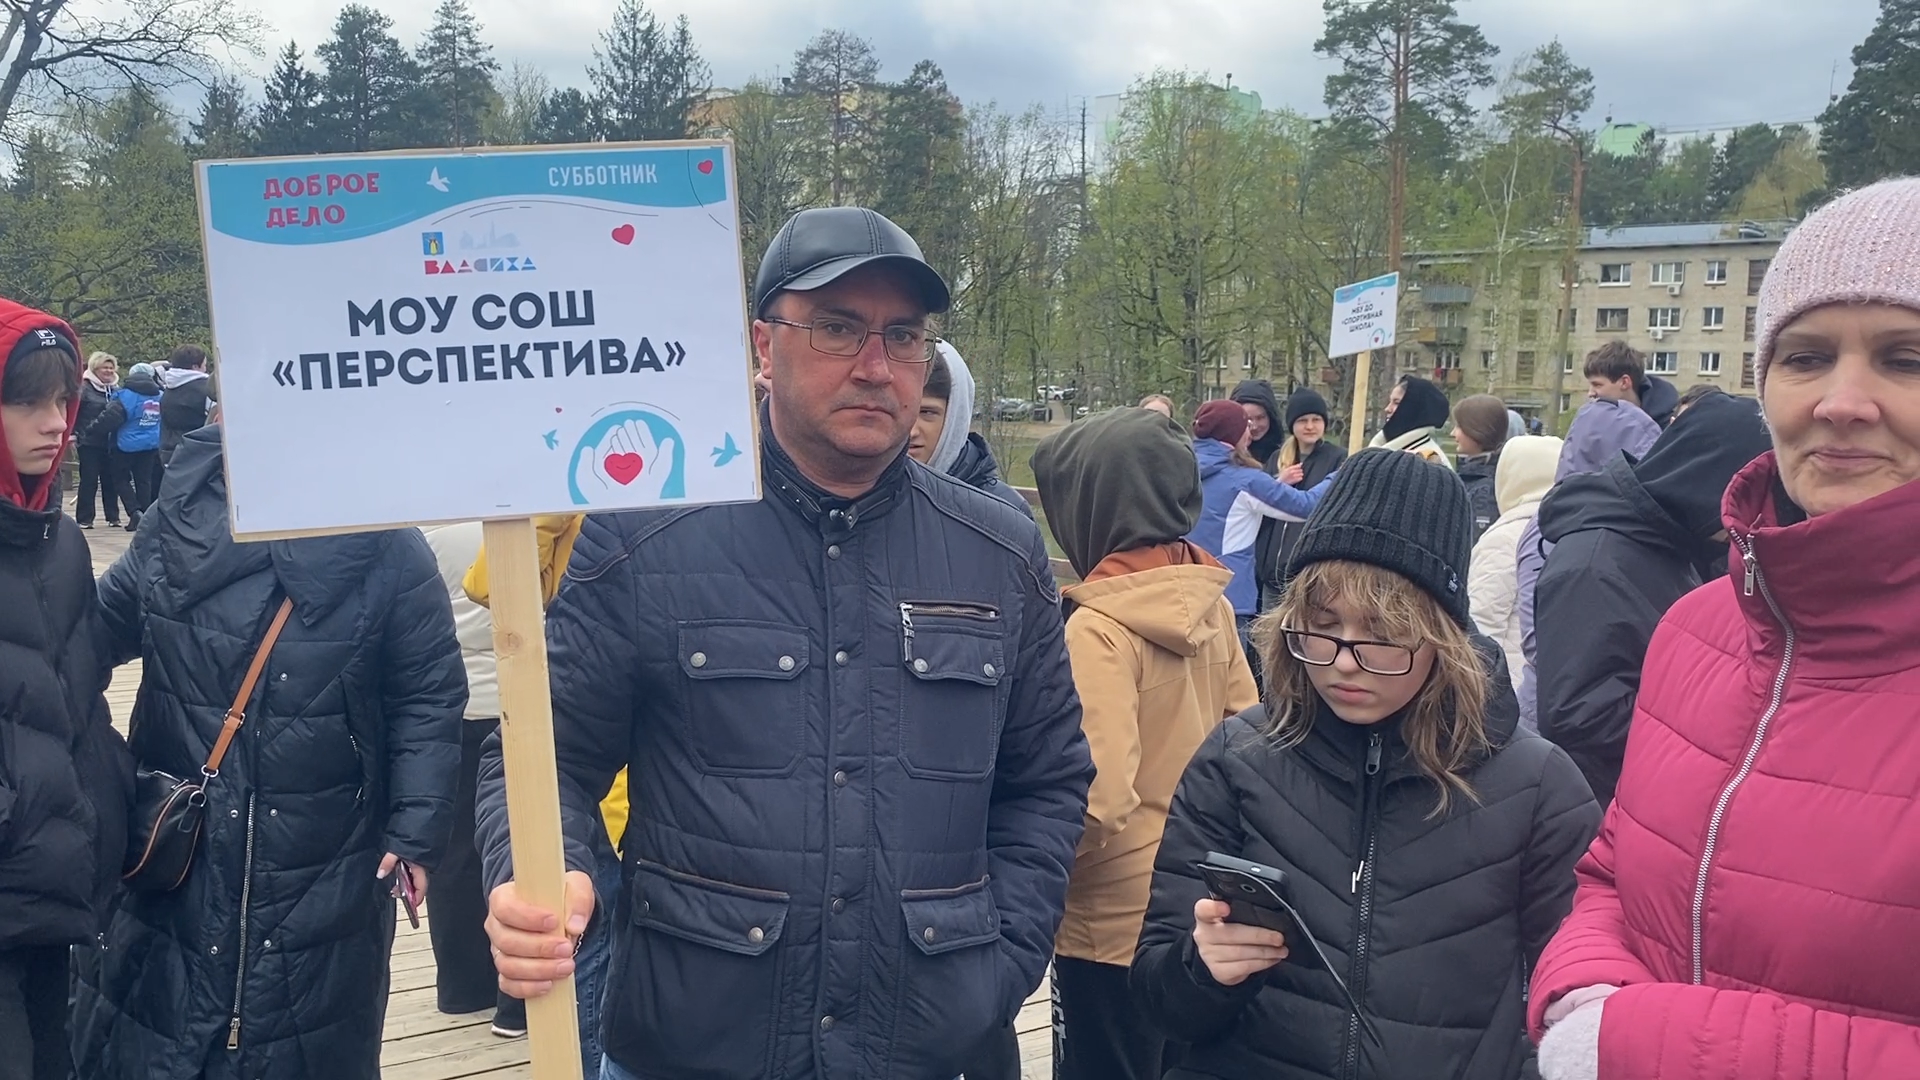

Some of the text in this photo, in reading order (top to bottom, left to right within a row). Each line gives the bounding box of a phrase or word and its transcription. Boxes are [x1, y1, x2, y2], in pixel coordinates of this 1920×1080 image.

[263, 172, 379, 200] ДОБРОЕ
[548, 164, 657, 188] СУББОТНИК
[266, 204, 345, 228] ДЕЛО
[347, 289, 595, 337] МОУ СОШ
[272, 336, 686, 391] «ПЕРСПЕКТИВА»
